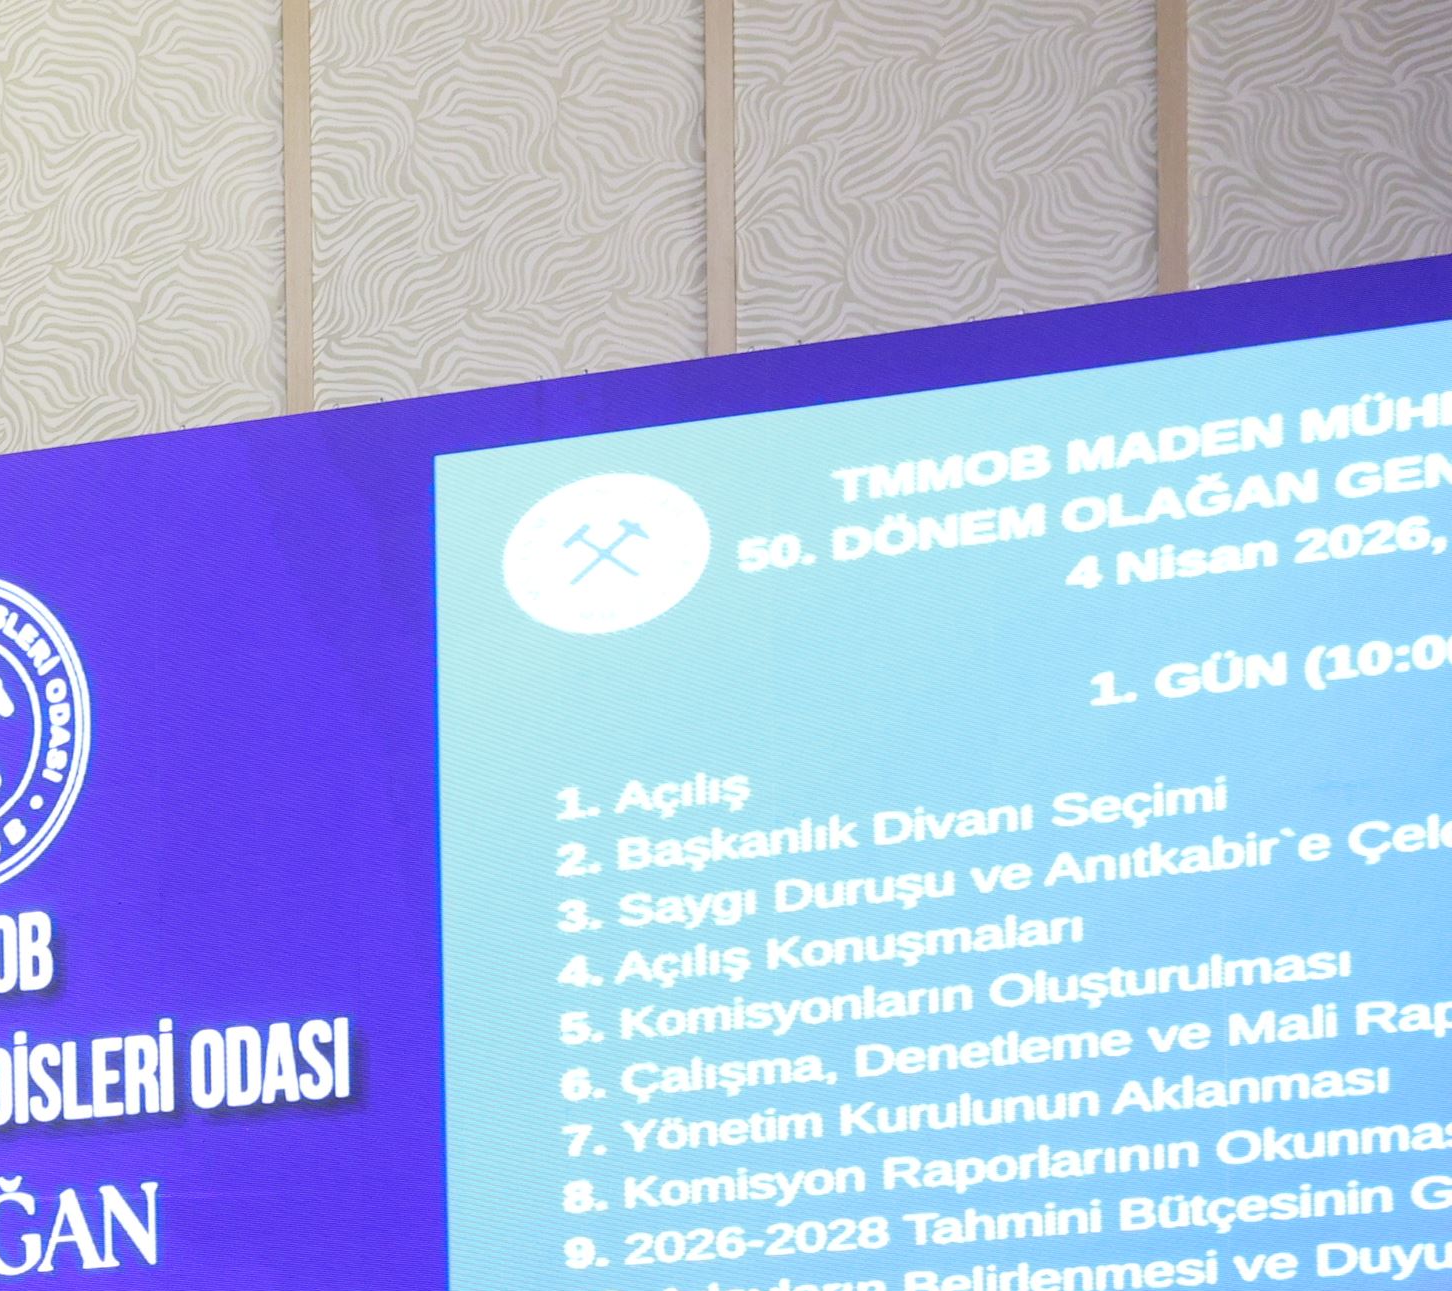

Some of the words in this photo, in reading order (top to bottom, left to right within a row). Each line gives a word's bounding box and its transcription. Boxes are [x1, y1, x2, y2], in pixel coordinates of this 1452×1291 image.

[834, 446, 1050, 501] TMMOB
[1069, 415, 1282, 472] MADEN
[740, 535, 814, 571] 50.
[834, 504, 1045, 560] DÖNEM
[1063, 470, 1317, 531] OLAĞAN
[1067, 556, 1101, 588] 4
[1118, 541, 1277, 584] Nisan
[1296, 517, 1445, 562] 2026,
[1093, 673, 1136, 705] 1.
[1156, 652, 1286, 697] GÜN
[1306, 636, 1452, 689] (10:0
[558, 788, 599, 819] 1.
[616, 773, 749, 817] Açılış
[558, 844, 600, 876] 2.
[619, 817, 856, 870] Başkanlık
[875, 806, 1031, 844] Divanı
[1054, 778, 1226, 827] Seçimi
[560, 900, 600, 932] 3.
[620, 891, 755, 928] Saygı
[777, 872, 954, 912] Duruşu
[972, 864, 1031, 892] ve
[559, 956, 602, 986] 4.
[617, 944, 750, 987] Açılış
[768, 916, 1082, 968] Konuşmaları
[561, 1013, 603, 1044] 5.
[622, 986, 972, 1038] Komisyonların
[991, 952, 1349, 1006] Oluşturulması
[191, 1018, 349, 1108] ODASI
[562, 1069, 604, 1100] 6.
[623, 1057, 835, 1102] Çalışma,
[857, 1031, 1131, 1076] Denetleme
[1149, 1024, 1209, 1051] ve
[1230, 1005, 1336, 1045] Mali
[564, 1125, 605, 1156] 7.
[623, 1109, 822, 1150] Yönetim
[841, 1092, 1098, 1134] Kurulunun
[1114, 1069, 1388, 1113] Aklanması
[564, 1181, 606, 1212] 8.
[625, 1168, 864, 1208] Komisyon
[885, 1143, 1198, 1192] Raporlarının
[566, 1238, 608, 1268] 9.
[626, 1217, 888, 1264] 2026-2028
[904, 1200, 1100, 1244] Tahmini
[1121, 1181, 1392, 1232] Bütçesinin
[1235, 1254, 1297, 1280] ve
